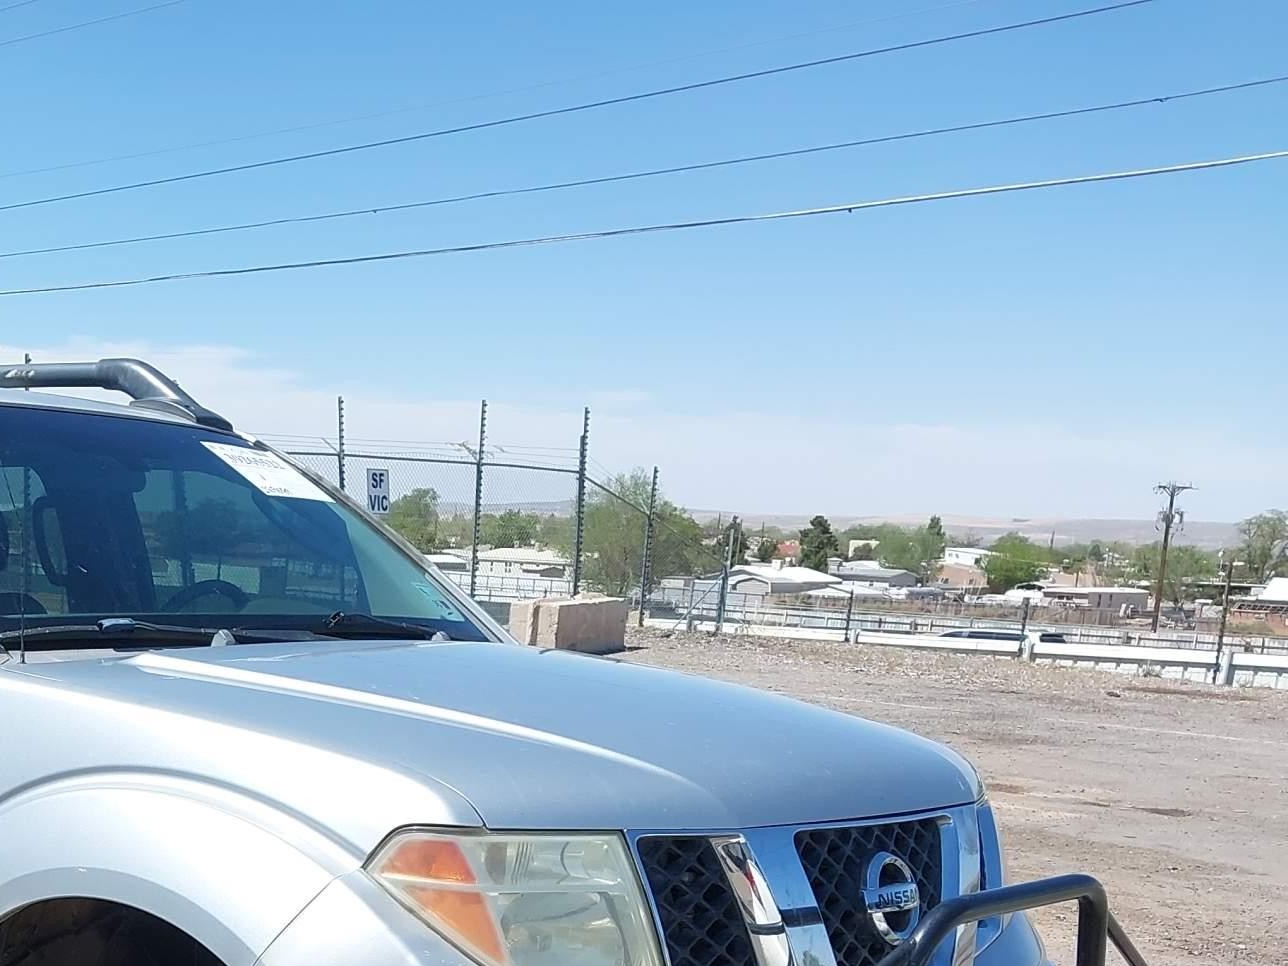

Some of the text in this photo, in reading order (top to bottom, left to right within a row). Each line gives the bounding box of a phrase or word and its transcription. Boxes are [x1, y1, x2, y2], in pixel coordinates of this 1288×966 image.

[371, 472, 385, 489] SF
[369, 494, 388, 512] VIC
[877, 889, 918, 907] NISSA
